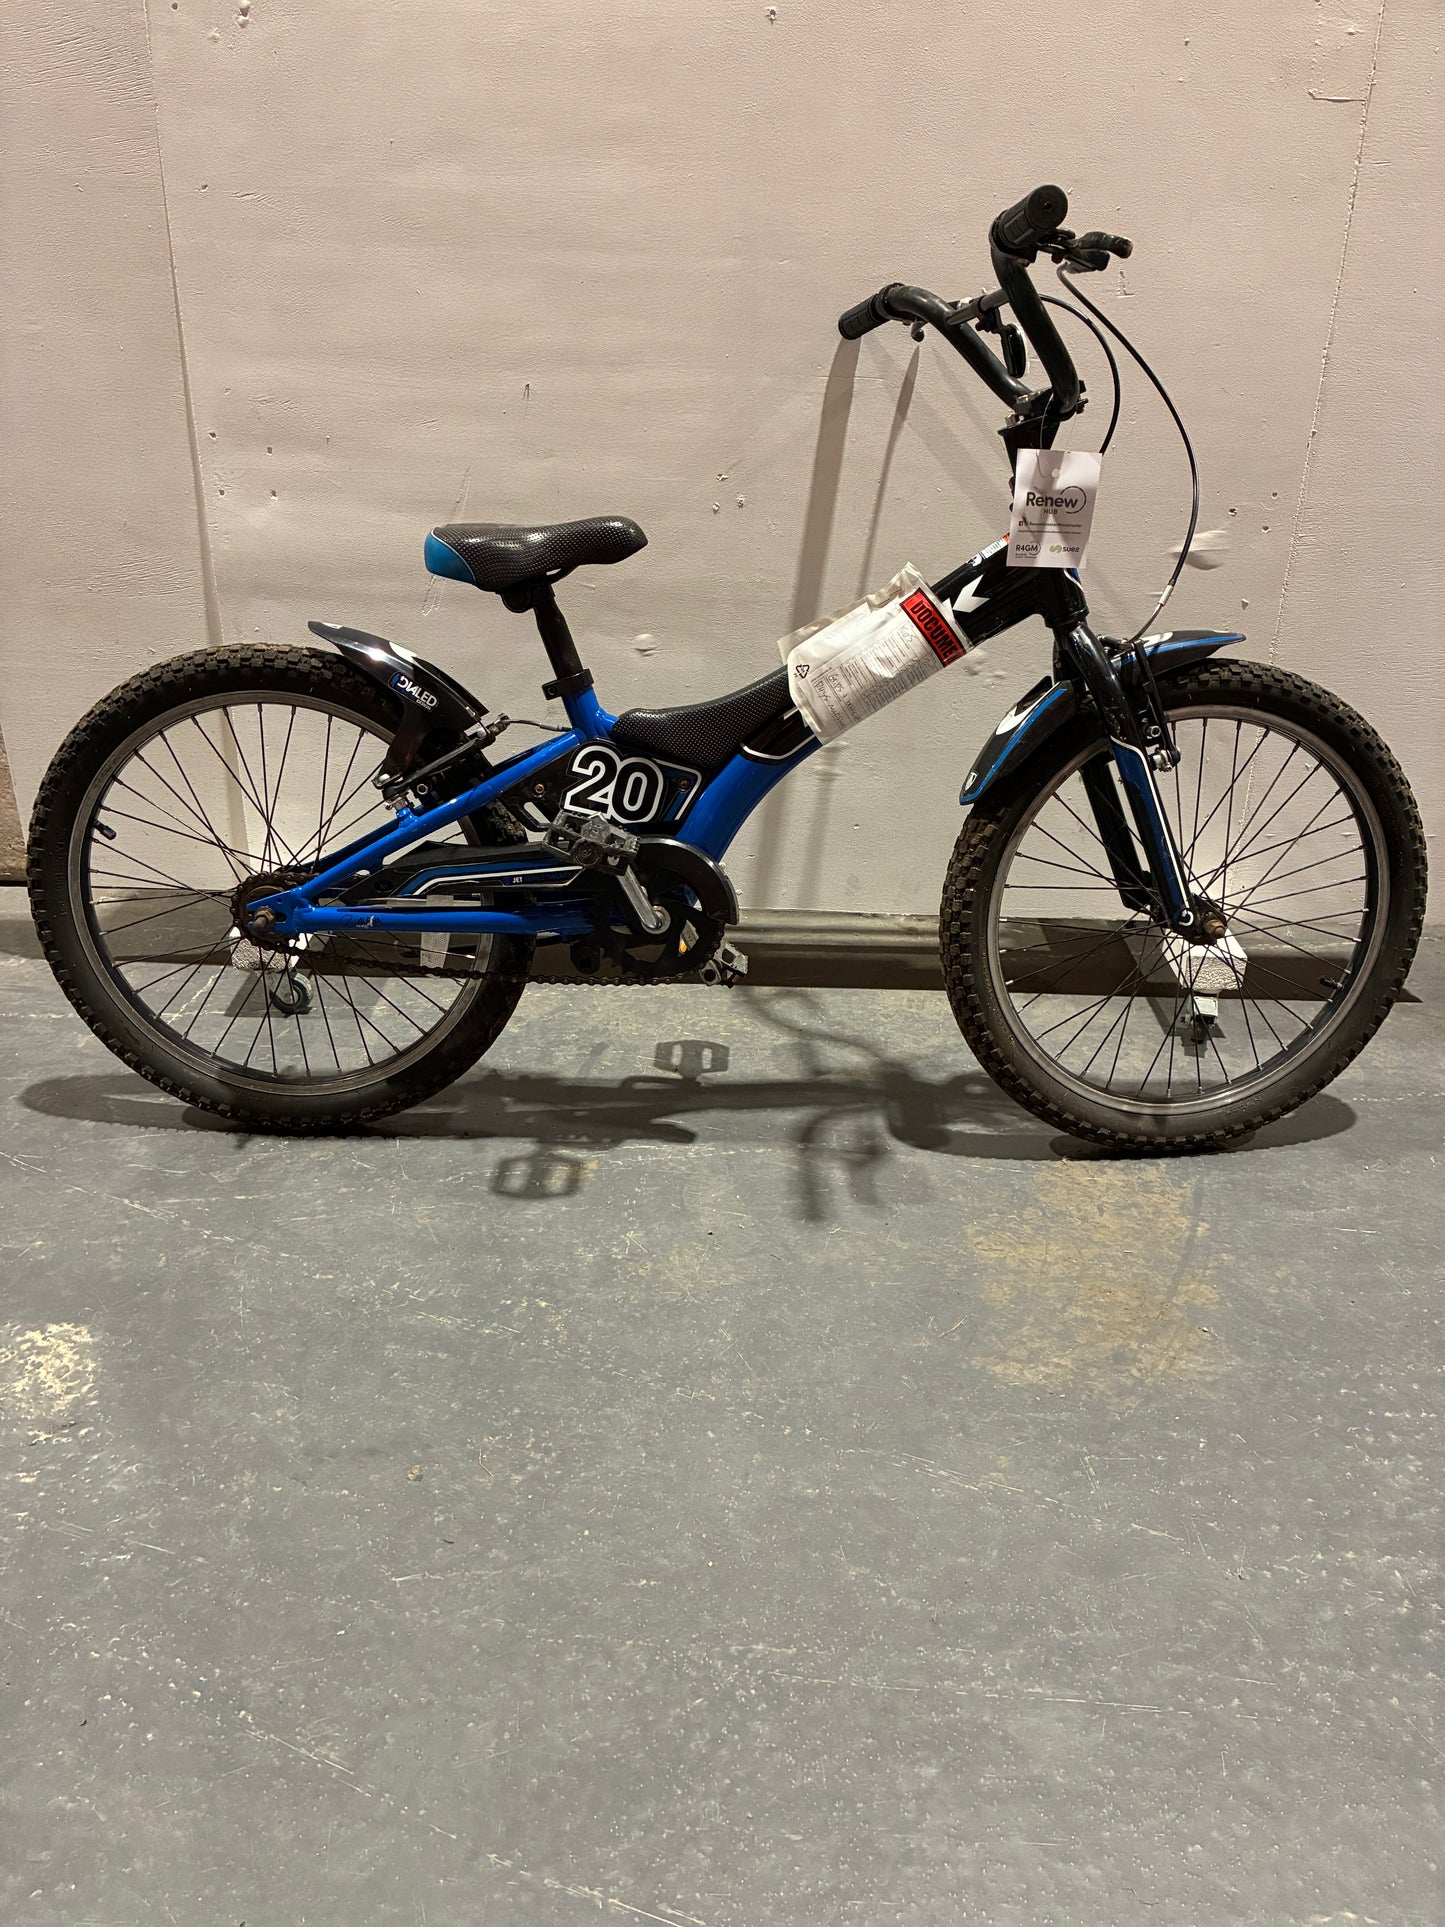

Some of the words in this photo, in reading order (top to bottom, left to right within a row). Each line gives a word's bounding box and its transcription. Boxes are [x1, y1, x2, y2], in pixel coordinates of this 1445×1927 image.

[1026, 491, 1079, 508] Renew
[1015, 543, 1039, 552] R4GM
[397, 676, 438, 707] DIALED
[563, 745, 664, 824] 20
[512, 876, 523, 884] JET
